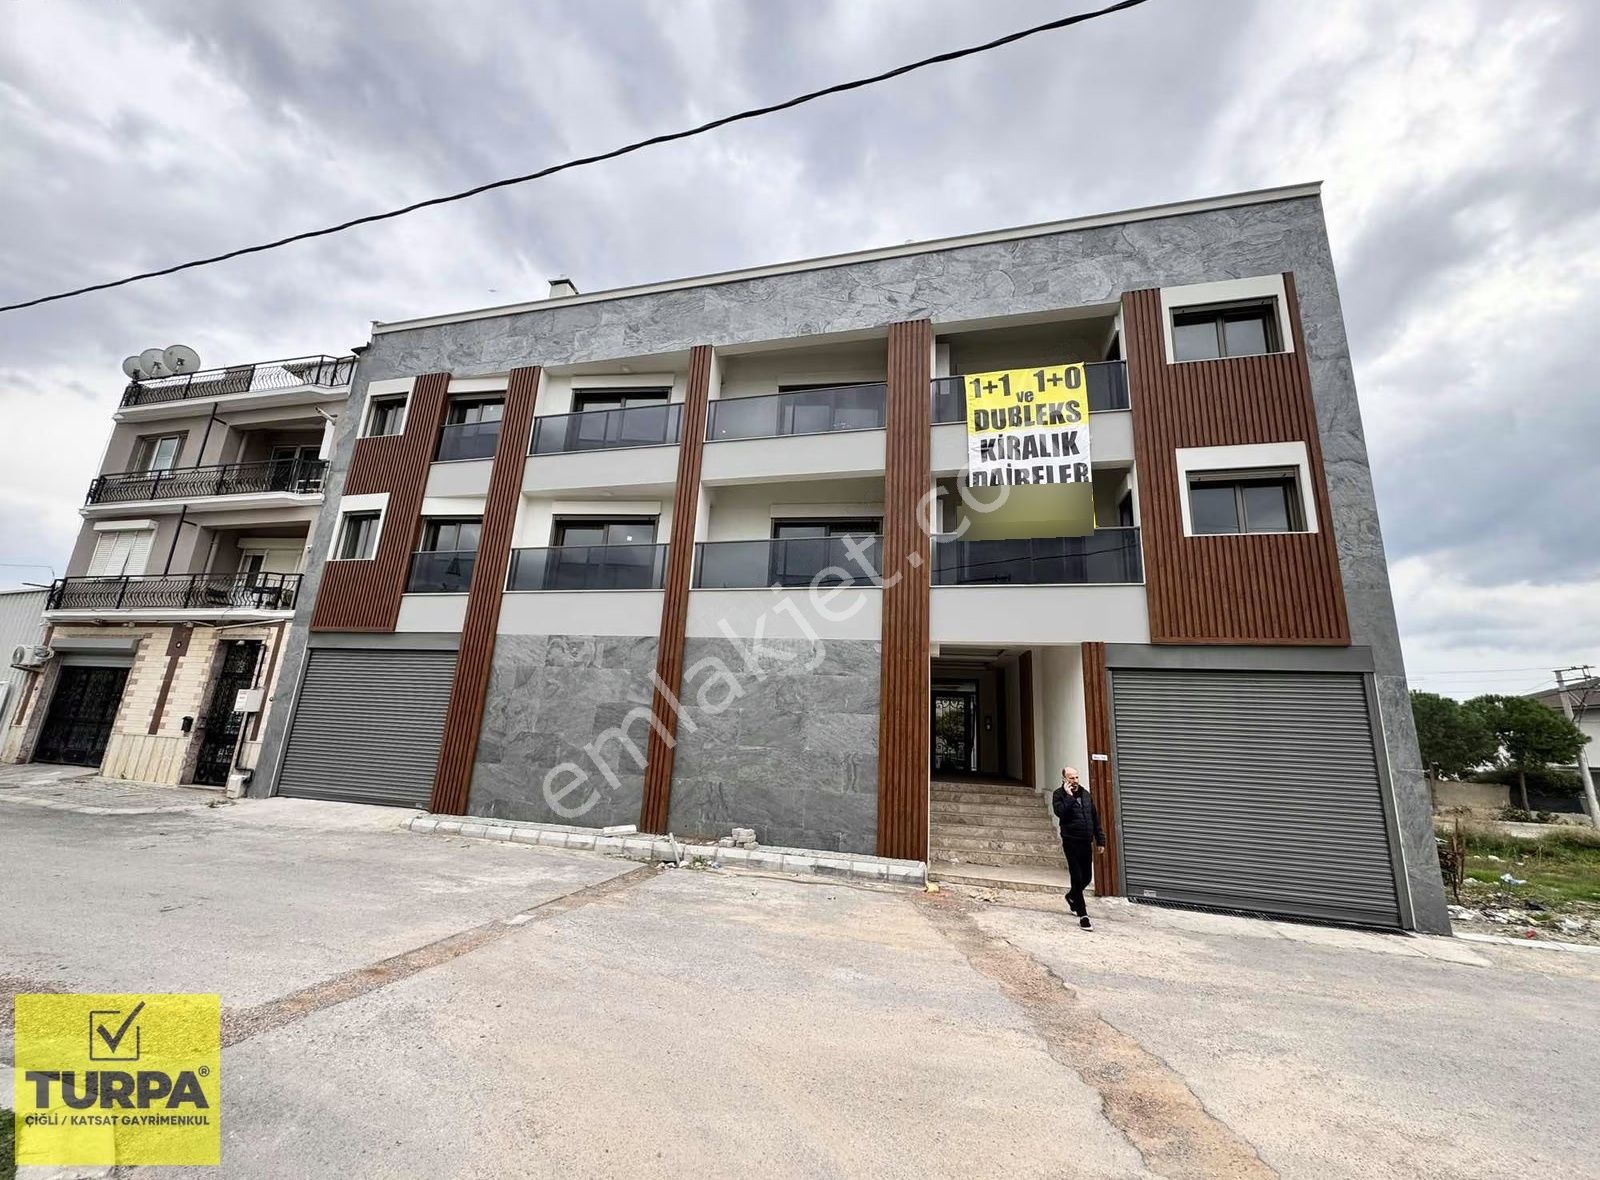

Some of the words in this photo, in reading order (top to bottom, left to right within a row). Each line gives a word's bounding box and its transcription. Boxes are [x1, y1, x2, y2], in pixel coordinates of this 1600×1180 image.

[969, 373, 1011, 399] 1+1
[1016, 390, 1034, 403] ve
[1033, 366, 1081, 393] 1+0
[974, 399, 1082, 432] DUBLEKS
[980, 430, 1080, 463] KİRALIK
